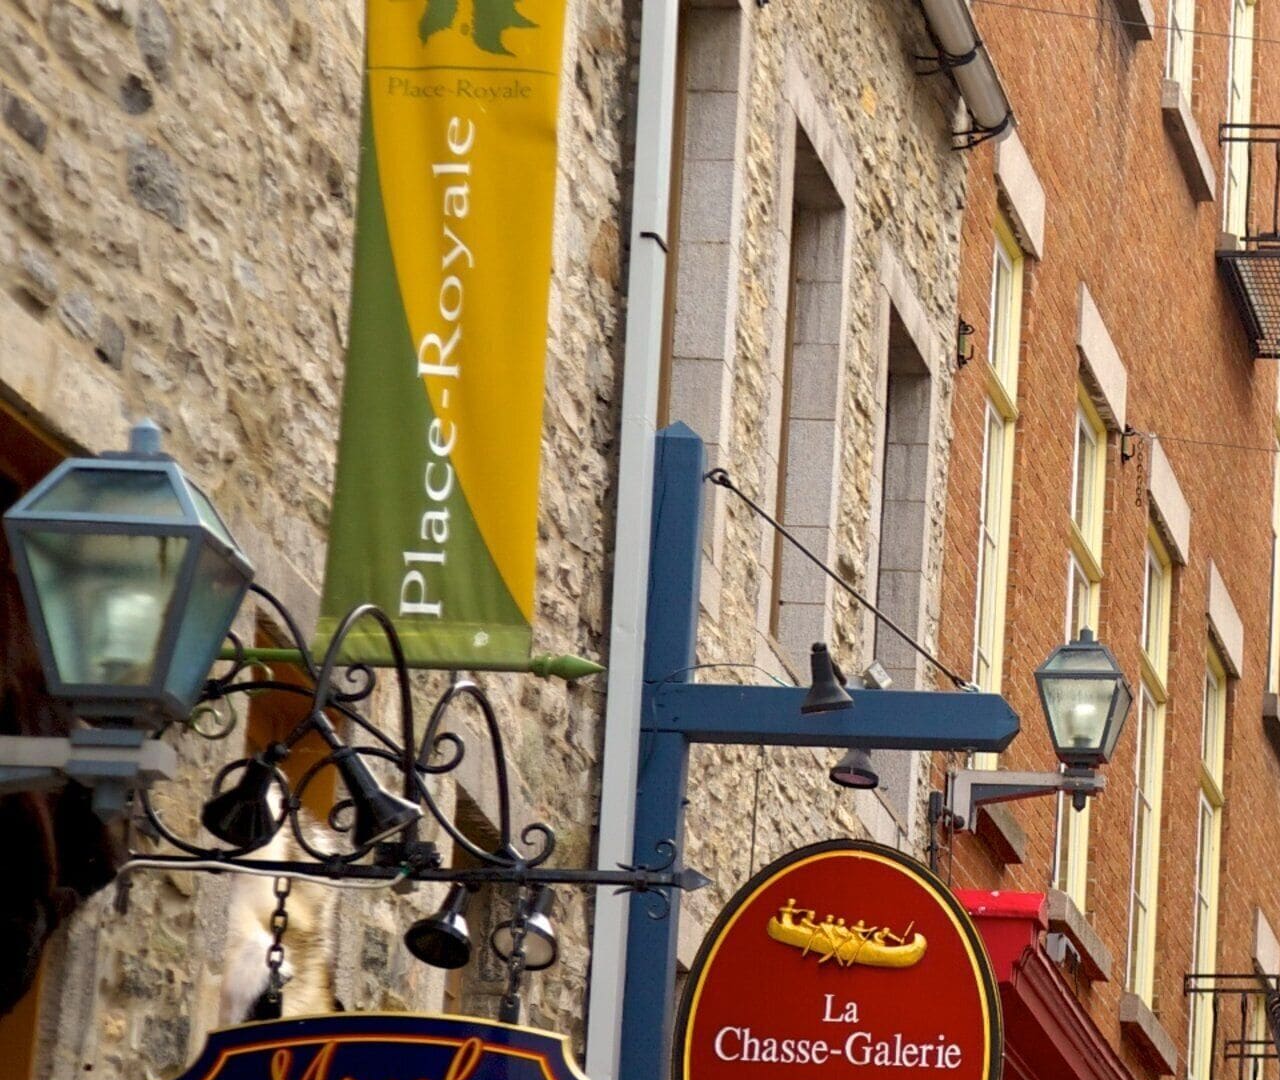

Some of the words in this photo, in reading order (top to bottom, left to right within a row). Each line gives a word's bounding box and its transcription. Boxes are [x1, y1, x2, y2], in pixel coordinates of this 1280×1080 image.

[387, 76, 531, 102] Place-Royale
[399, 115, 476, 618] Place-Royale
[822, 993, 859, 1023] La
[713, 1025, 962, 1069] Chasse-Galerie
